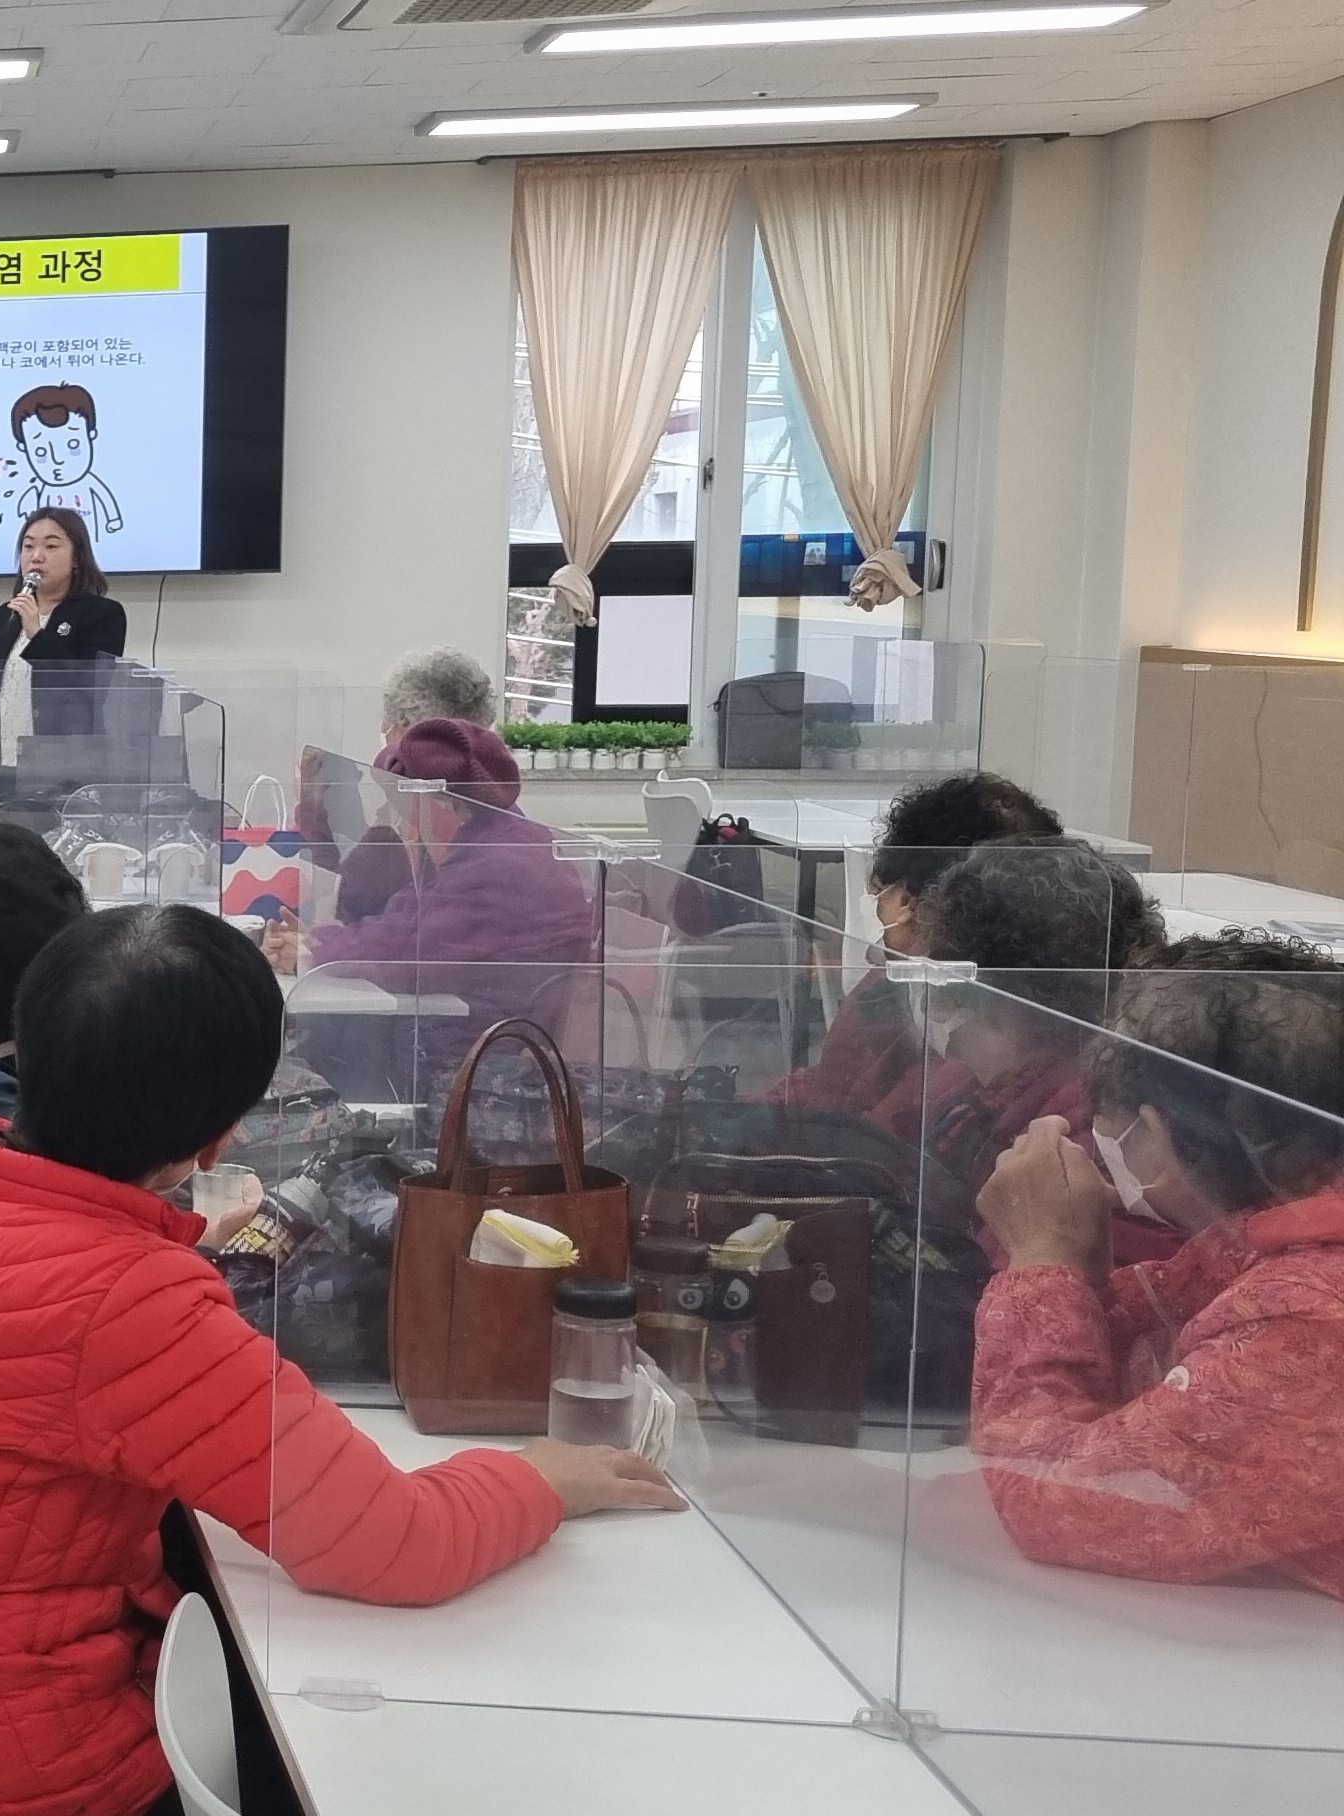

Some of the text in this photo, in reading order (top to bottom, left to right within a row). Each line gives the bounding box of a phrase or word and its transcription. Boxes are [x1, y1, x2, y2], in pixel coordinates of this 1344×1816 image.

[37, 249, 103, 283] 과정
[42, 338, 98, 353] 포함되어
[104, 337, 133, 351] 있는
[20, 355, 62, 368] 코에서
[67, 354, 95, 367] 튀어
[100, 352, 147, 366] 나온다.
